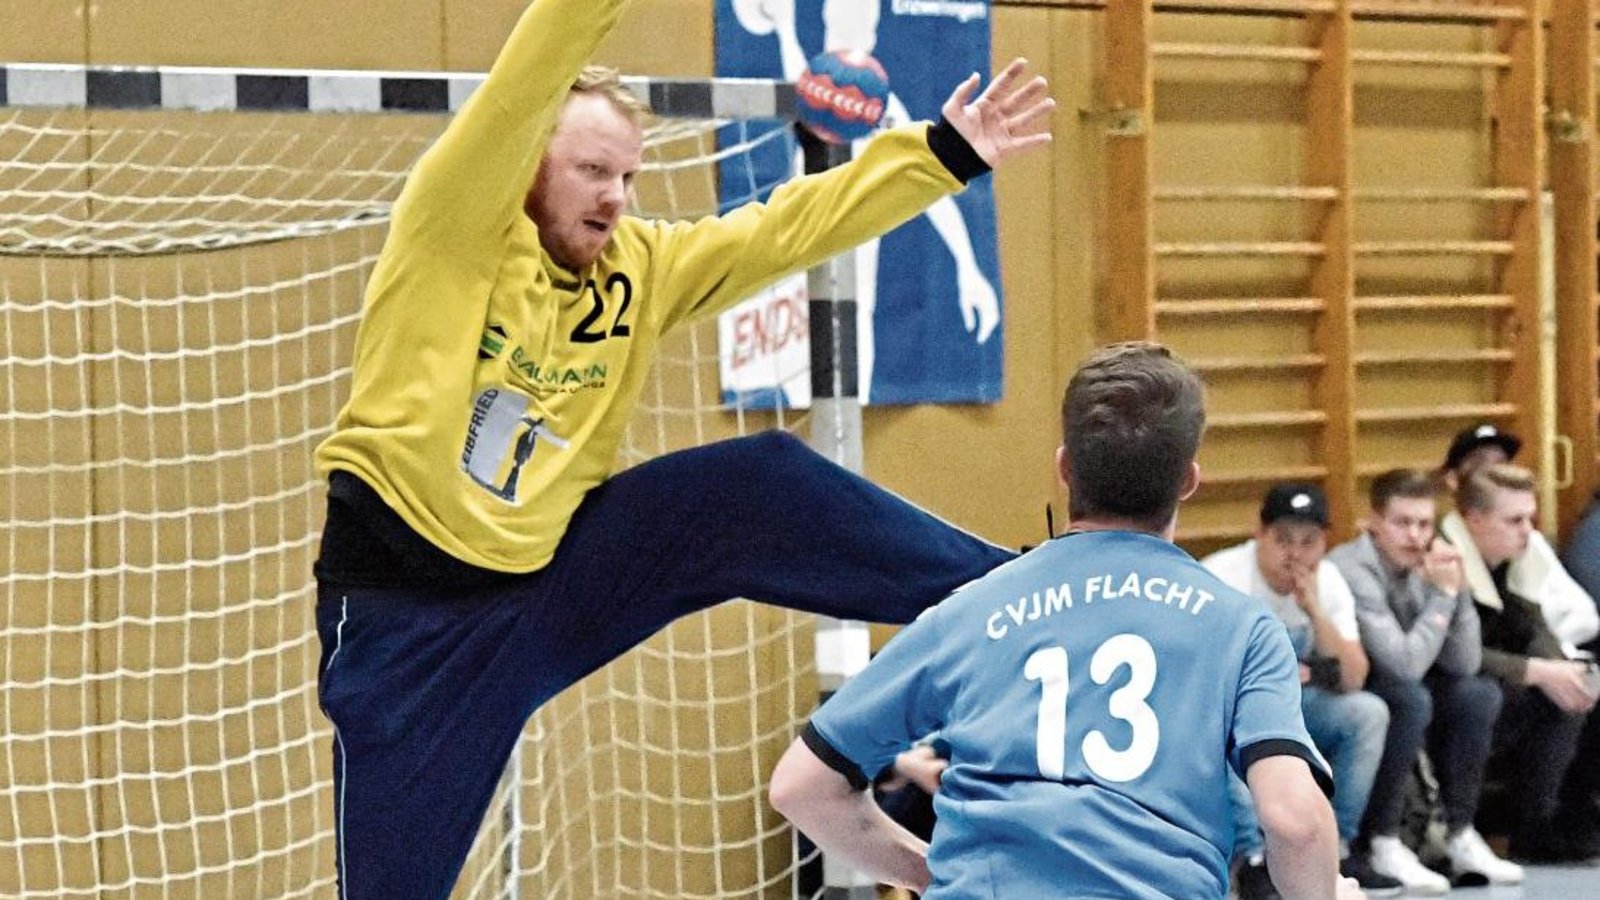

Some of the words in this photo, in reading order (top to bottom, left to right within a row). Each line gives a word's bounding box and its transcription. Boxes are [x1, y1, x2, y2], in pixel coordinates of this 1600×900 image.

[570, 272, 632, 343] 22
[986, 583, 1073, 640] CVJM
[1085, 572, 1215, 616] FLACHT
[1024, 633, 1160, 782] 13
